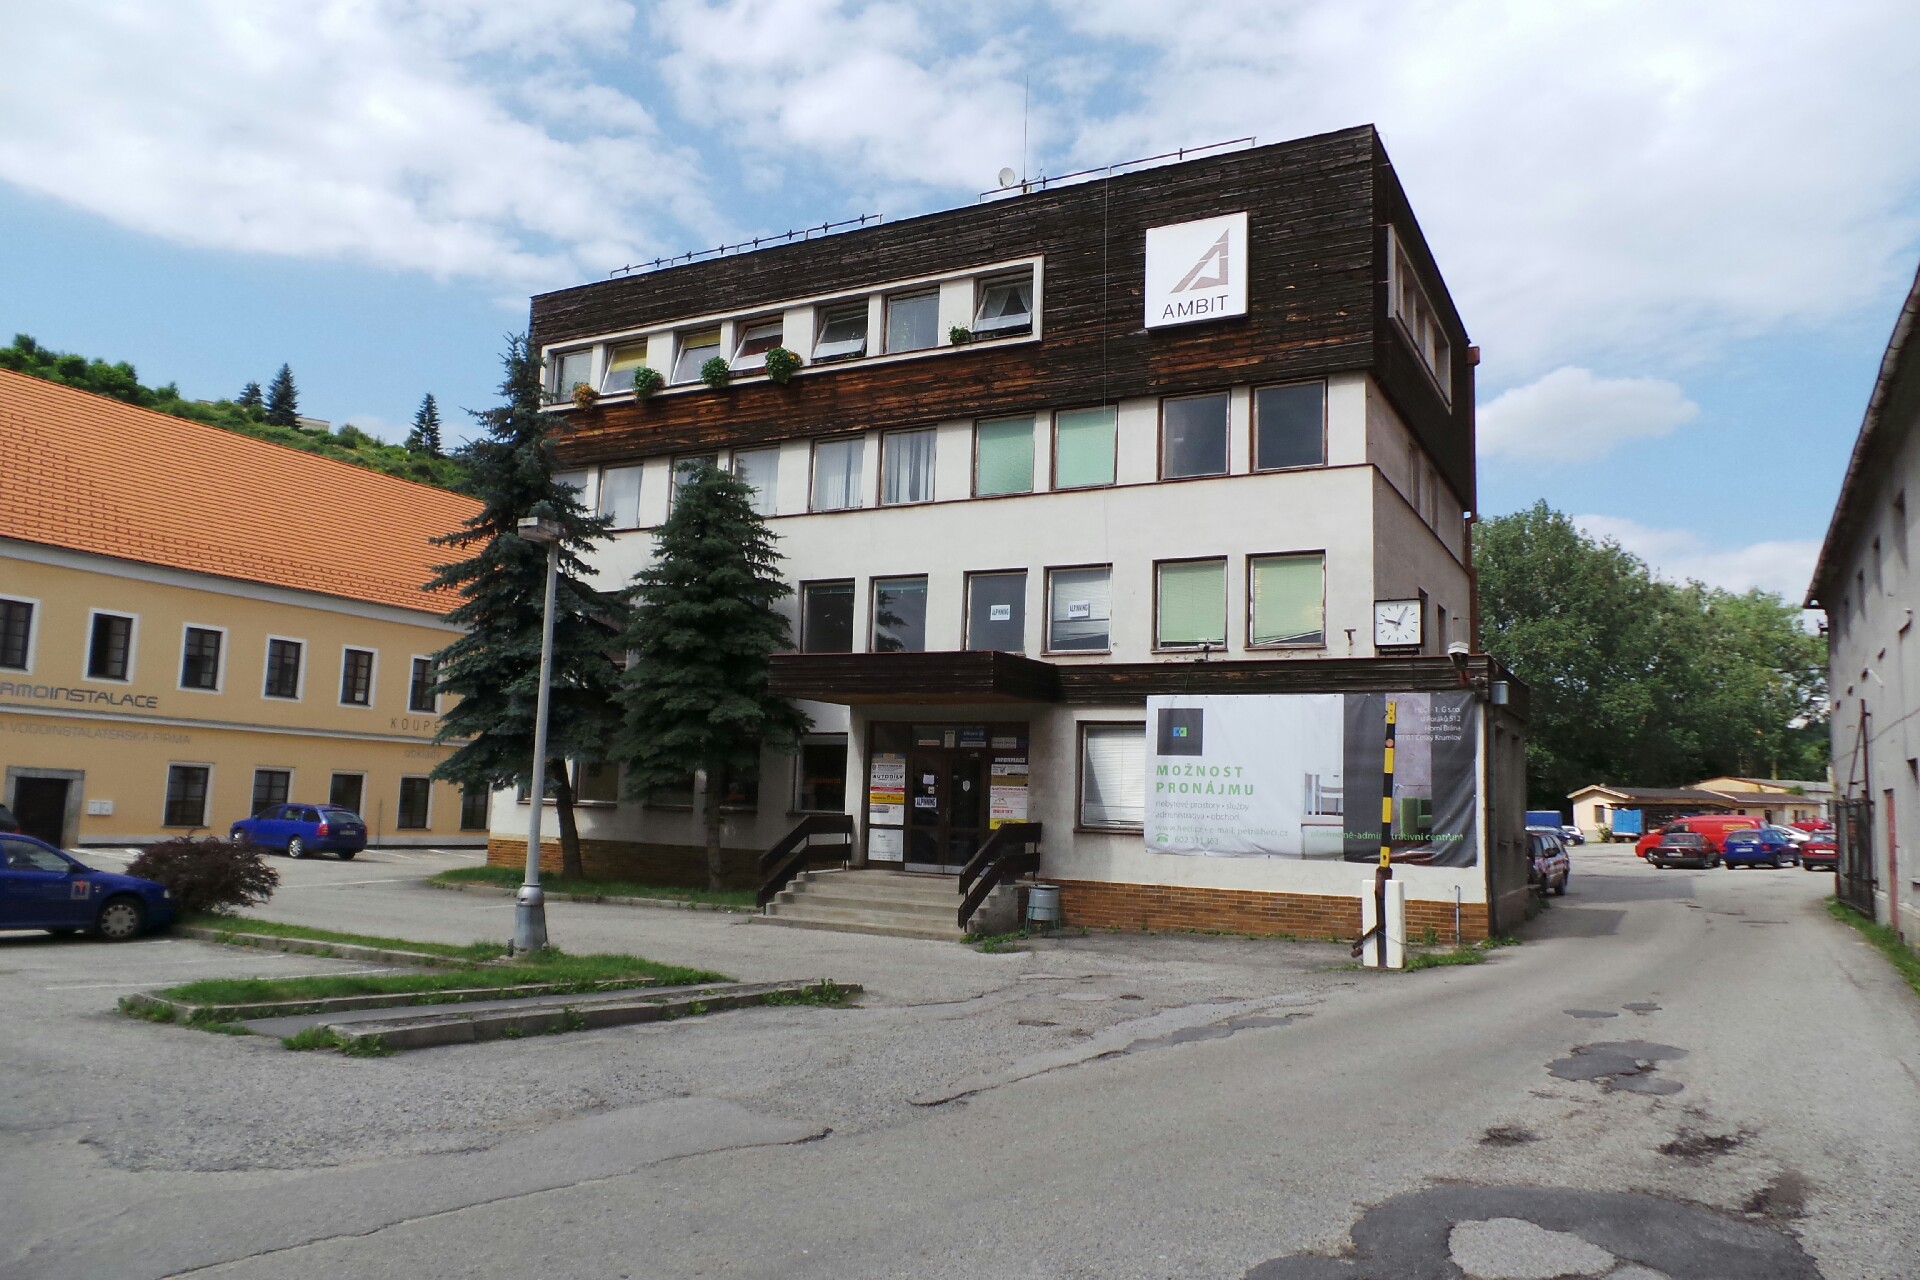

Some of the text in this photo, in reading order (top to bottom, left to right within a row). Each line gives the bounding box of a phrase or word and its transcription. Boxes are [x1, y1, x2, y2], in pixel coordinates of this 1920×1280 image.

[1162, 295, 1229, 319] AMBIT
[390, 717, 443, 732] KOUPE
[1156, 763, 1243, 778] MOŽNOST
[1156, 780, 1254, 796] PRONÁJMU
[1155, 800, 1249, 812] nebytové prostory služby
[1155, 811, 1240, 821] administrativa obchod
[1425, 832, 1464, 842] centrum
